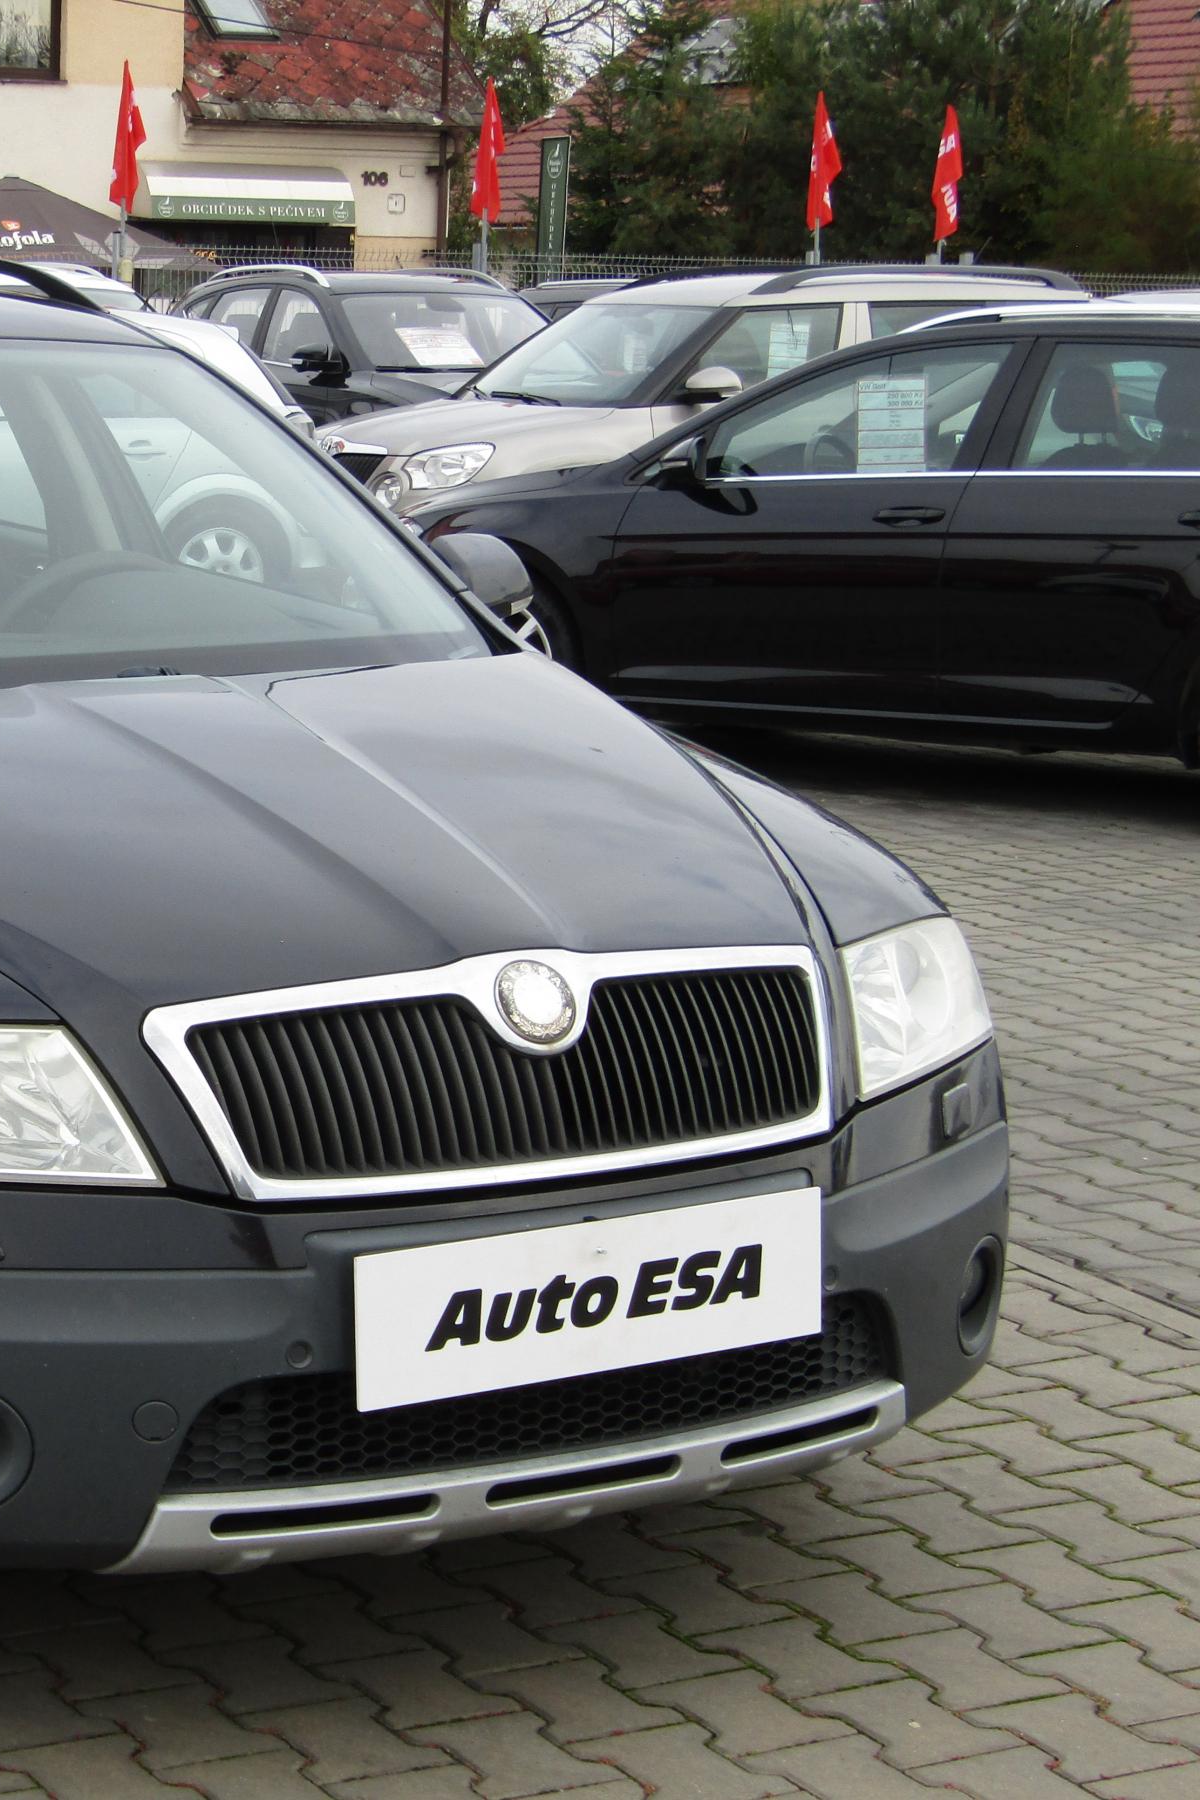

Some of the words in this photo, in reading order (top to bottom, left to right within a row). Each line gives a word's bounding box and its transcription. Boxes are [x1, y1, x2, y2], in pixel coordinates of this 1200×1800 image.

[361, 171, 388, 187] 106
[182, 202, 255, 216] OBCHŮDEK
[258, 205, 267, 216] S
[270, 205, 326, 218] PEČIVEM
[424, 1274, 619, 1352] Auto
[626, 1243, 763, 1318] ESA
